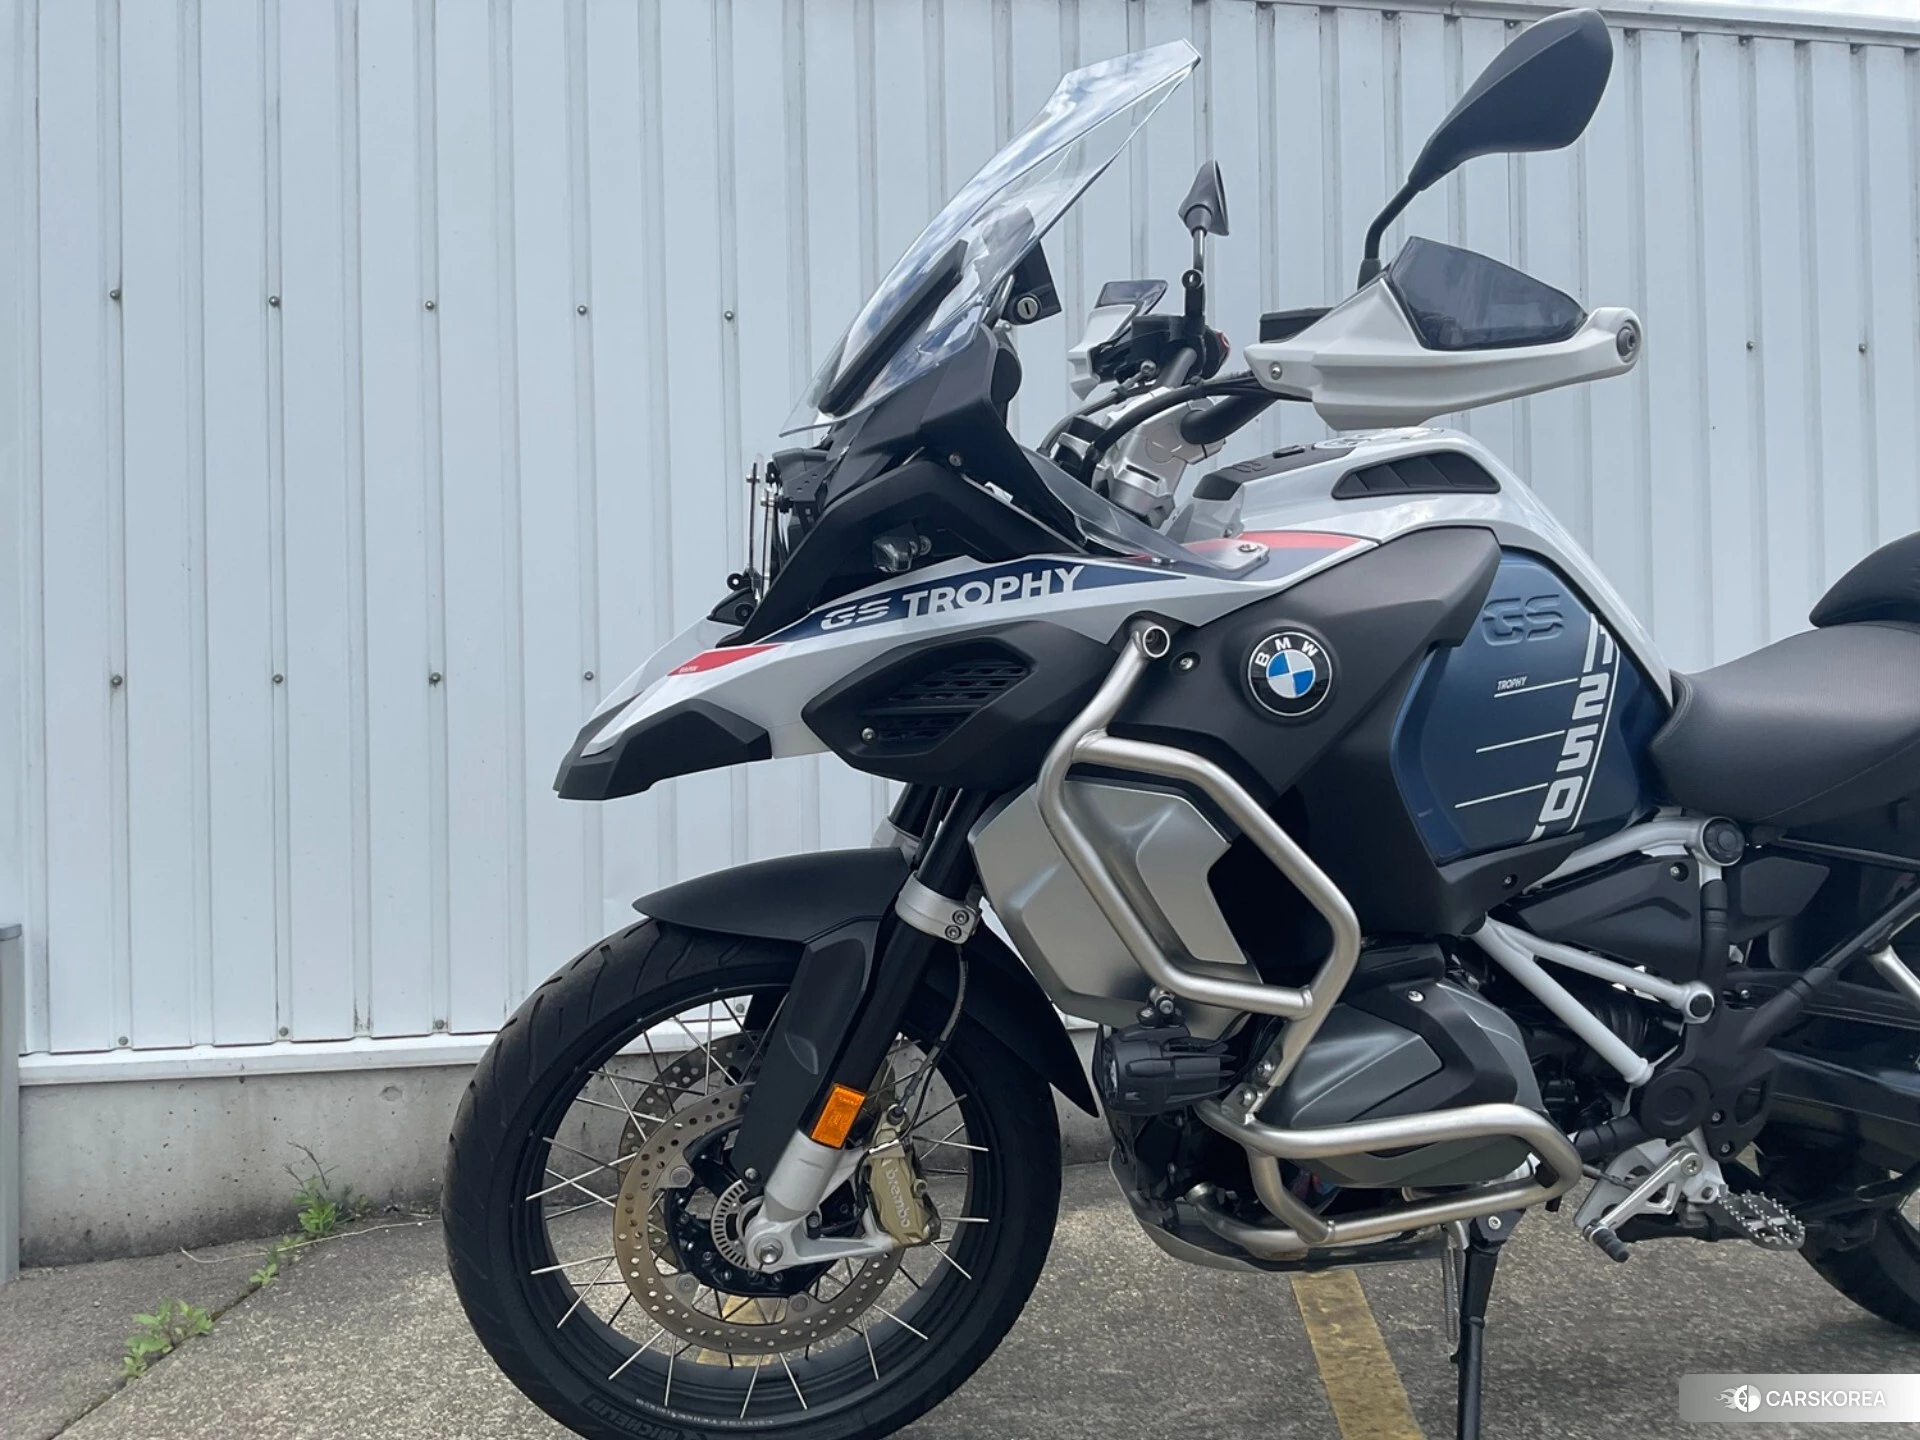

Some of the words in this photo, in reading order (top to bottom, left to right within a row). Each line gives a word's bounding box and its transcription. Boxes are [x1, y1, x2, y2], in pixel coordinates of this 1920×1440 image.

[820, 597, 892, 631] GS
[902, 565, 1085, 619] TROPHY
[1481, 594, 1564, 646] GS
[1254, 636, 1319, 668] BMW
[886, 1167, 910, 1228] brembo
[586, 1397, 679, 1440] MICHELIN
